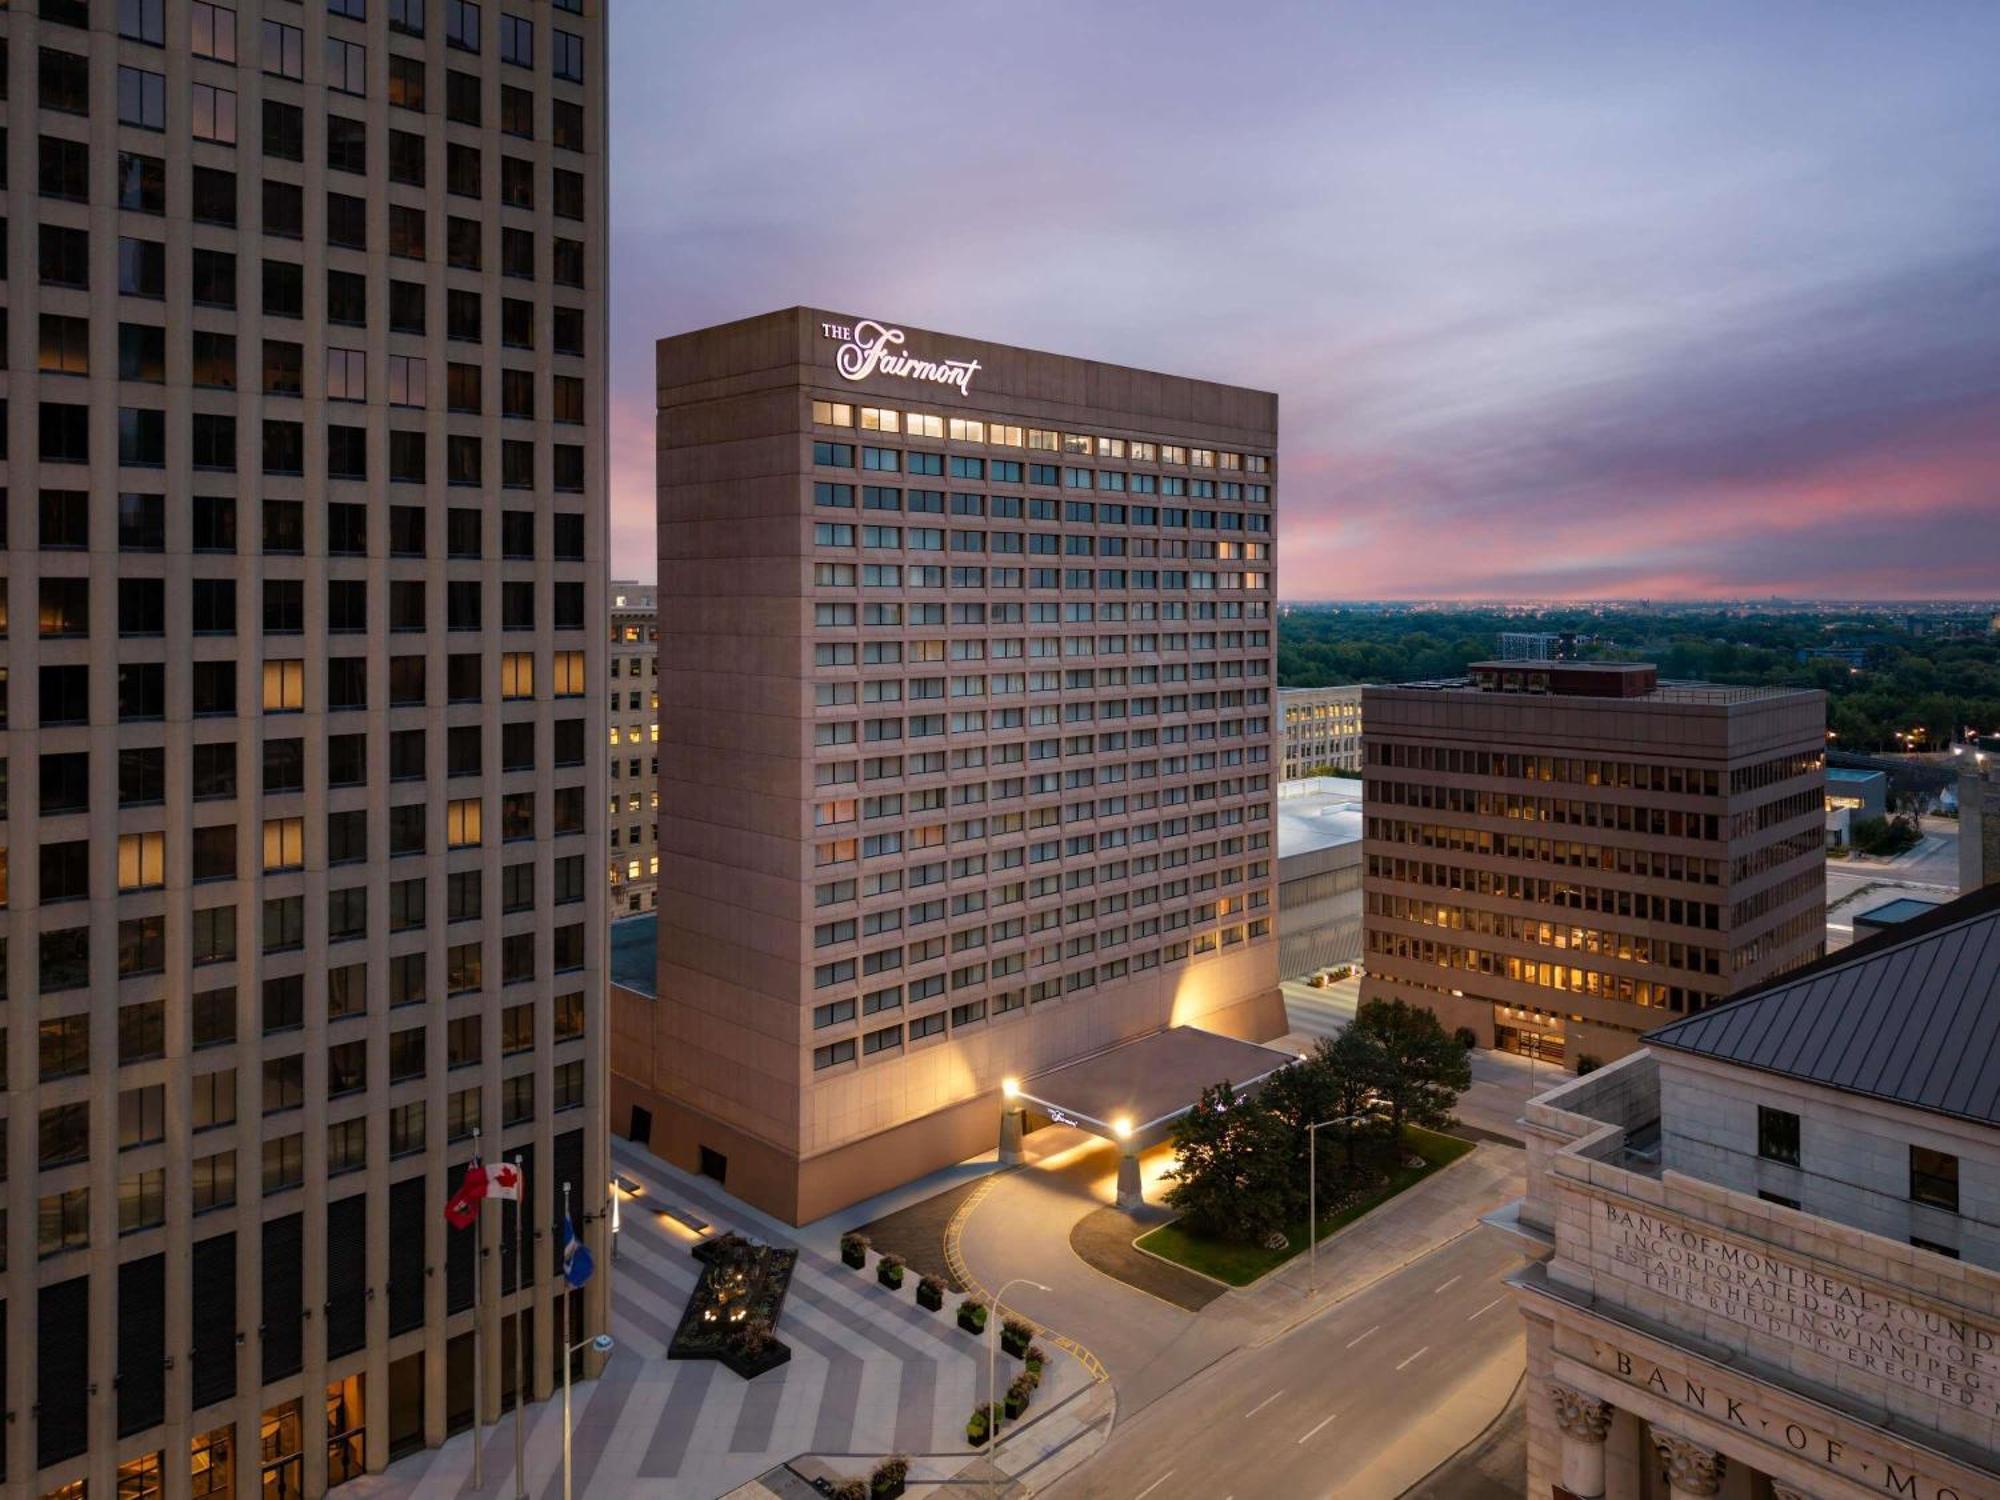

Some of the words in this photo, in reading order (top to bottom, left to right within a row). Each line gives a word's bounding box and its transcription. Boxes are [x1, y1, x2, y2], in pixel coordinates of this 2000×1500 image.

[822, 323, 851, 340] THE
[836, 320, 982, 396] Fairmont
[1607, 1204, 1672, 1242] BANK
[1681, 1231, 1711, 1252] OF
[1721, 1245, 1873, 1311] MONTREAL
[1887, 1300, 1993, 1350] FOUND
[1615, 1245, 1776, 1312] ESTABLISHED
[1790, 1308, 1815, 1329] IN
[1829, 1322, 1980, 1389] WINNIPEG
[1624, 1231, 1819, 1312] INCORPORATED
[1834, 1304, 1864, 1326] BY
[1876, 1322, 1936, 1350] ACT
[1947, 1344, 1984, 1368] OF
[1642, 1272, 1693, 1300] THIS
[1848, 1348, 1974, 1405] ERECTED
[1616, 1352, 1749, 1427] BANK
[1785, 1423, 1843, 1464] OF
